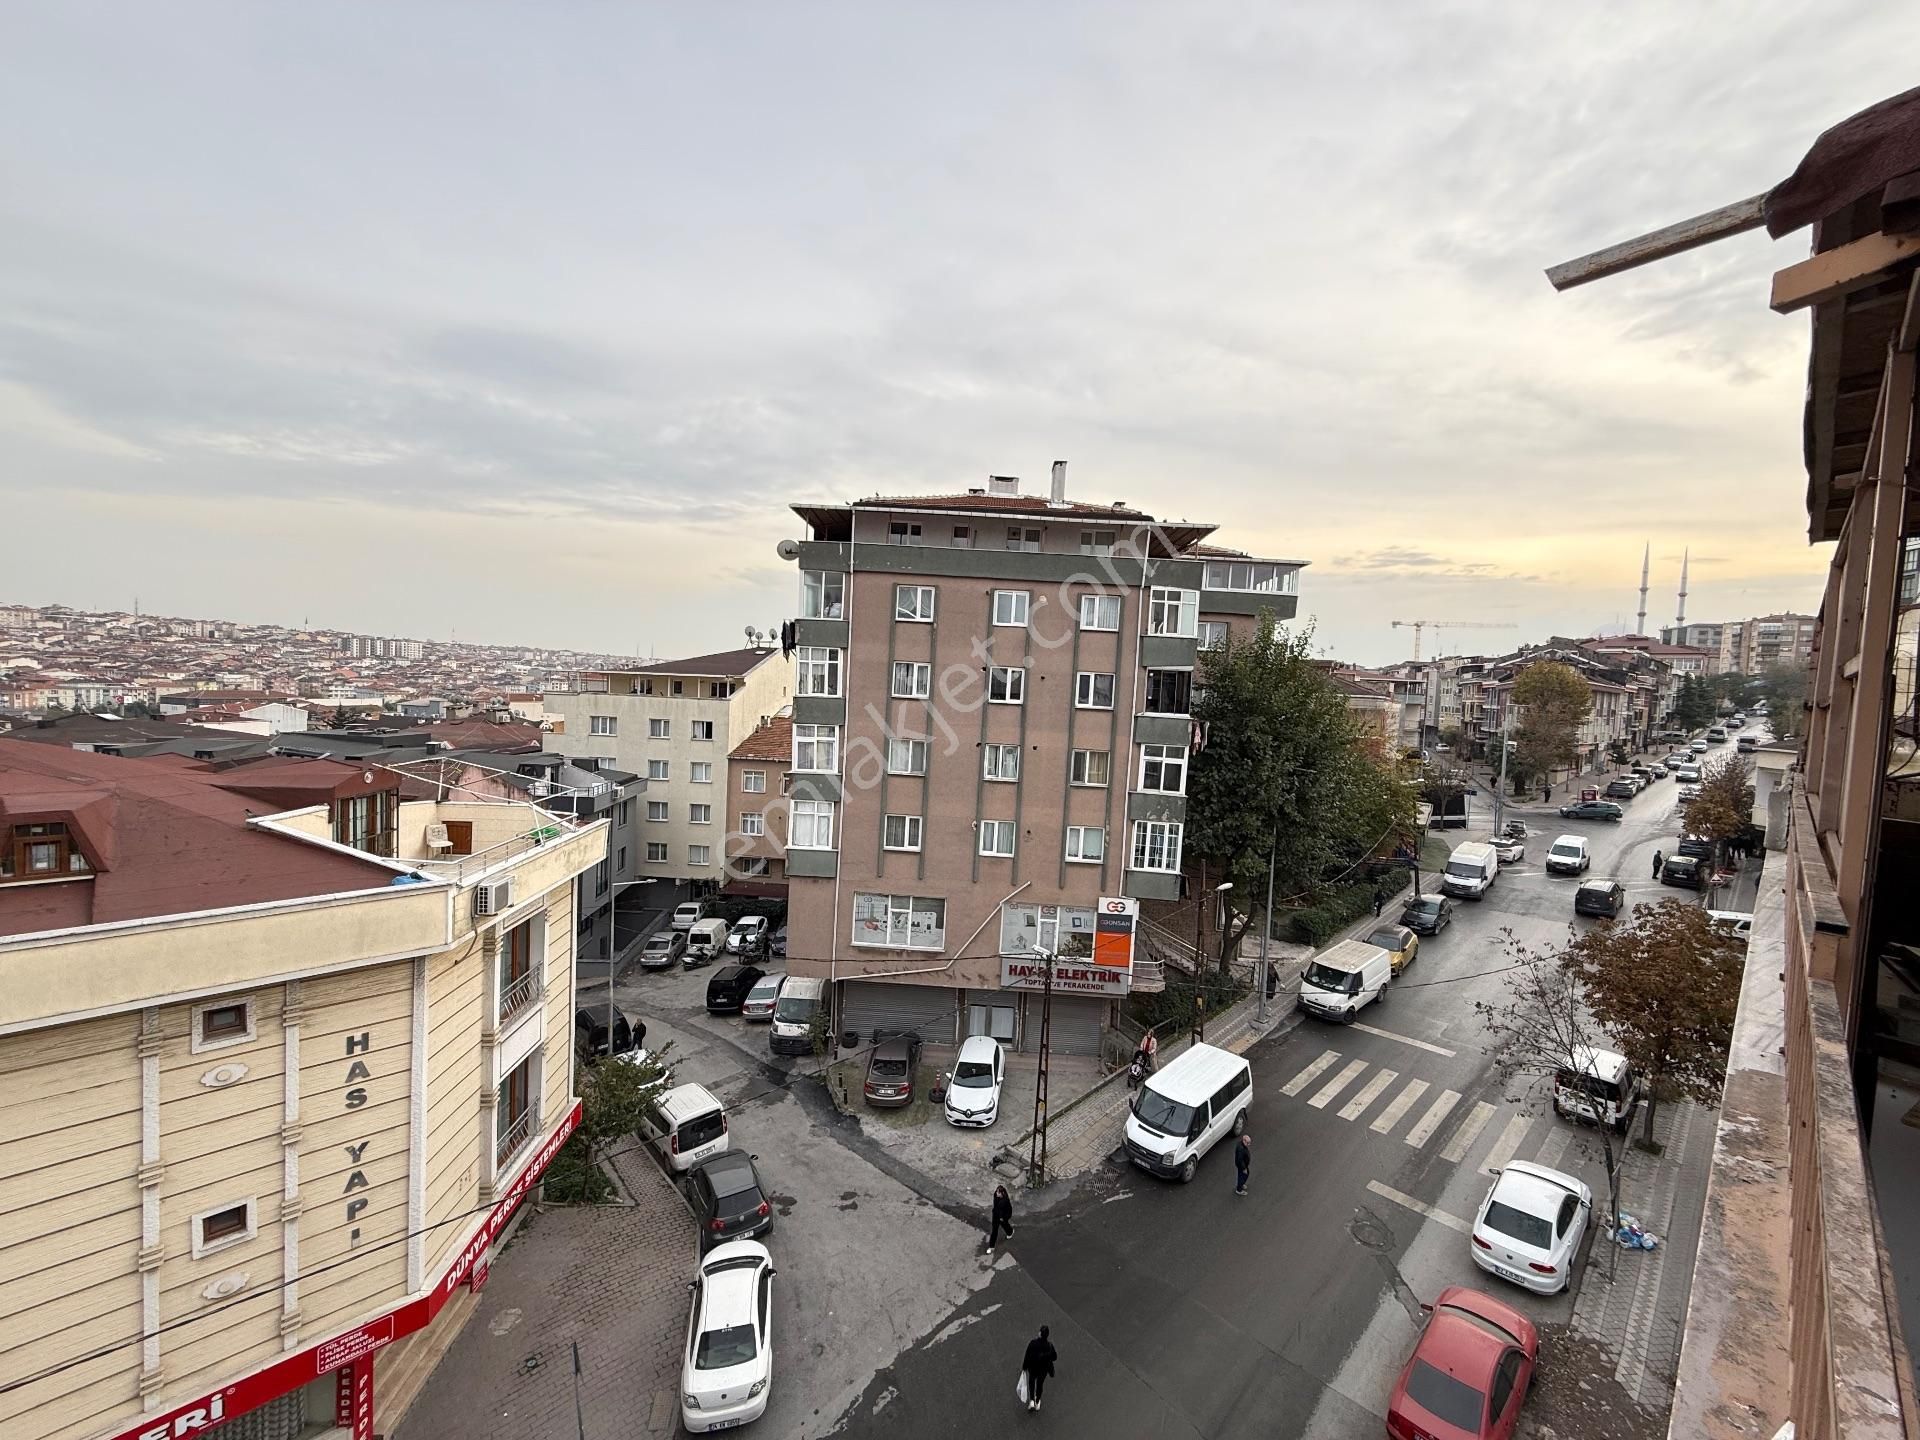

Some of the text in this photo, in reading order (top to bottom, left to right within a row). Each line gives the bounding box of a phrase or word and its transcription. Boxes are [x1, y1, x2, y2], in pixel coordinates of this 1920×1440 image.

[1056, 968, 1121, 983] ELEKTRİK
[1063, 981, 1105, 991] PERAKENDE
[342, 1031, 371, 1249] HAS YAPI
[447, 1116, 572, 1293] DÜNYA PERDE SİSTEMLERİ
[325, 1332, 363, 1352] TÜL PERDE
[346, 1334, 369, 1348] PERDE
[367, 1336, 389, 1350] PERDE
[341, 1368, 351, 1417] PERDE
